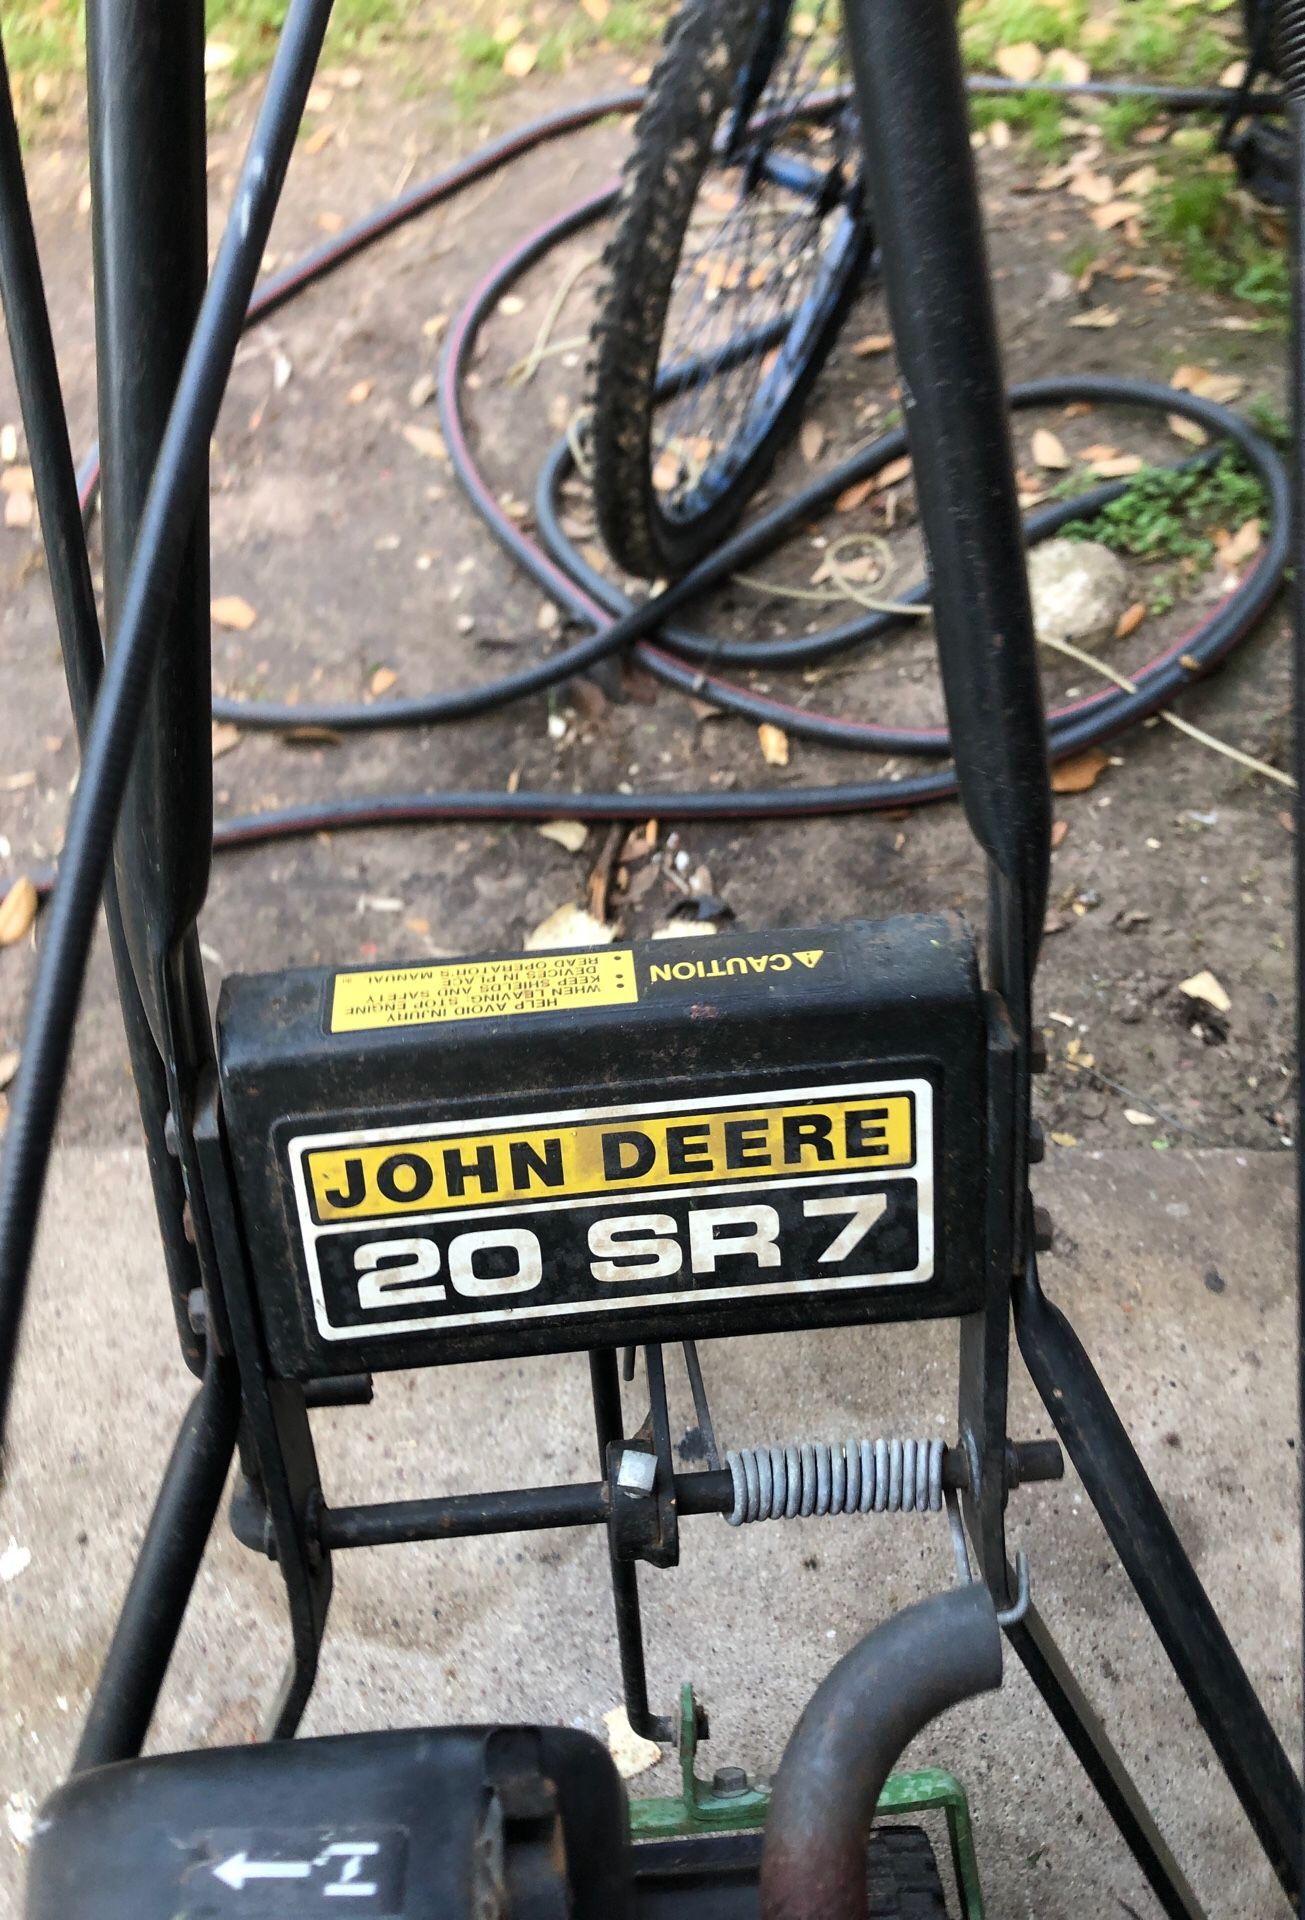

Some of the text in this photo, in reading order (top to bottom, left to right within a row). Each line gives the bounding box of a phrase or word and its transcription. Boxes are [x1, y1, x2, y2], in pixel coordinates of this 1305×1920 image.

[440, 961, 547, 977] OPERATOR'S
[554, 957, 599, 967] READ
[650, 953, 793, 982] CAUTION
[364, 971, 433, 984] MANUAL
[443, 966, 597, 986] DEVICES IN PLACE
[366, 975, 600, 1003] KEEP SHIELDS AND SAFETY
[551, 984, 601, 996] WHEN
[345, 1002, 406, 1015] ENGINE
[387, 998, 558, 1022] HELP AVOID INJURY
[414, 997, 458, 1009] STOP
[326, 1107, 890, 1209] JOHN DEERE
[354, 1193, 887, 1310] 20 SR 7
